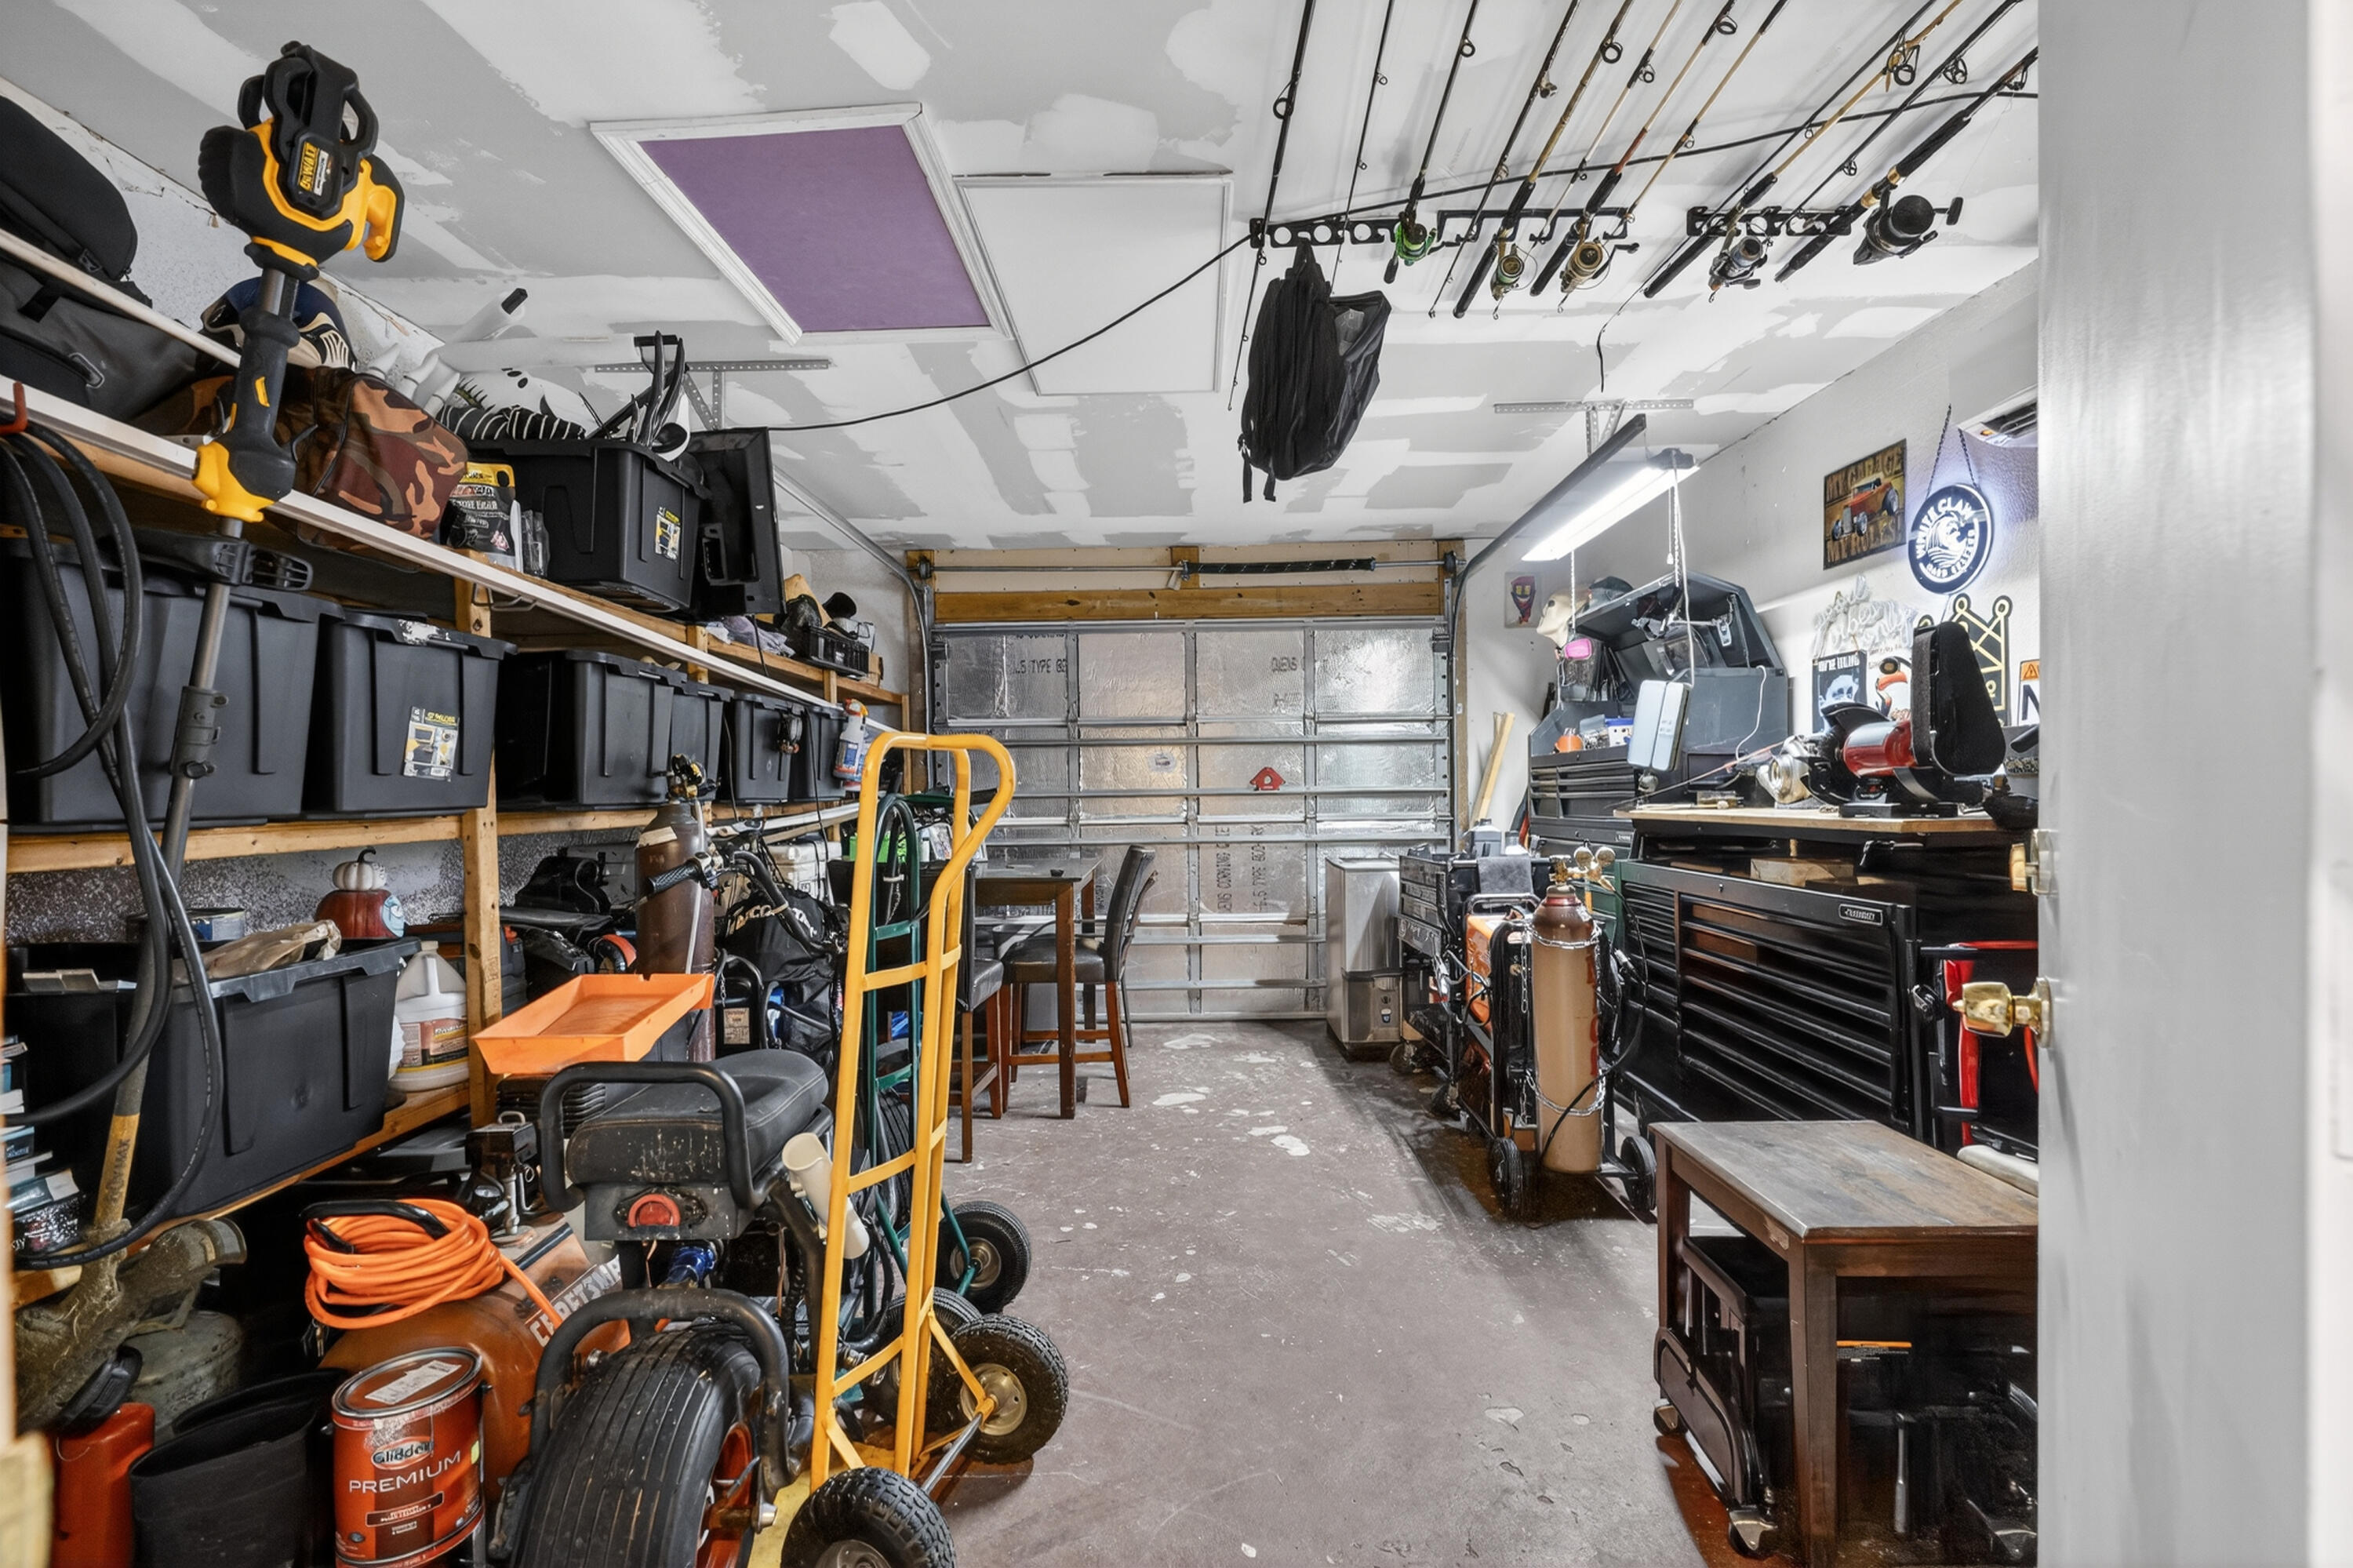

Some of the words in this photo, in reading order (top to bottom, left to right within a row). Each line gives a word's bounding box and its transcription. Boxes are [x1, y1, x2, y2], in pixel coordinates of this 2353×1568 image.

[300, 142, 318, 191] DEWALT
[1915, 506, 1941, 559] WHITE
[1937, 497, 1975, 521] CLAW
[348, 1450, 461, 1493] PREMIUM
